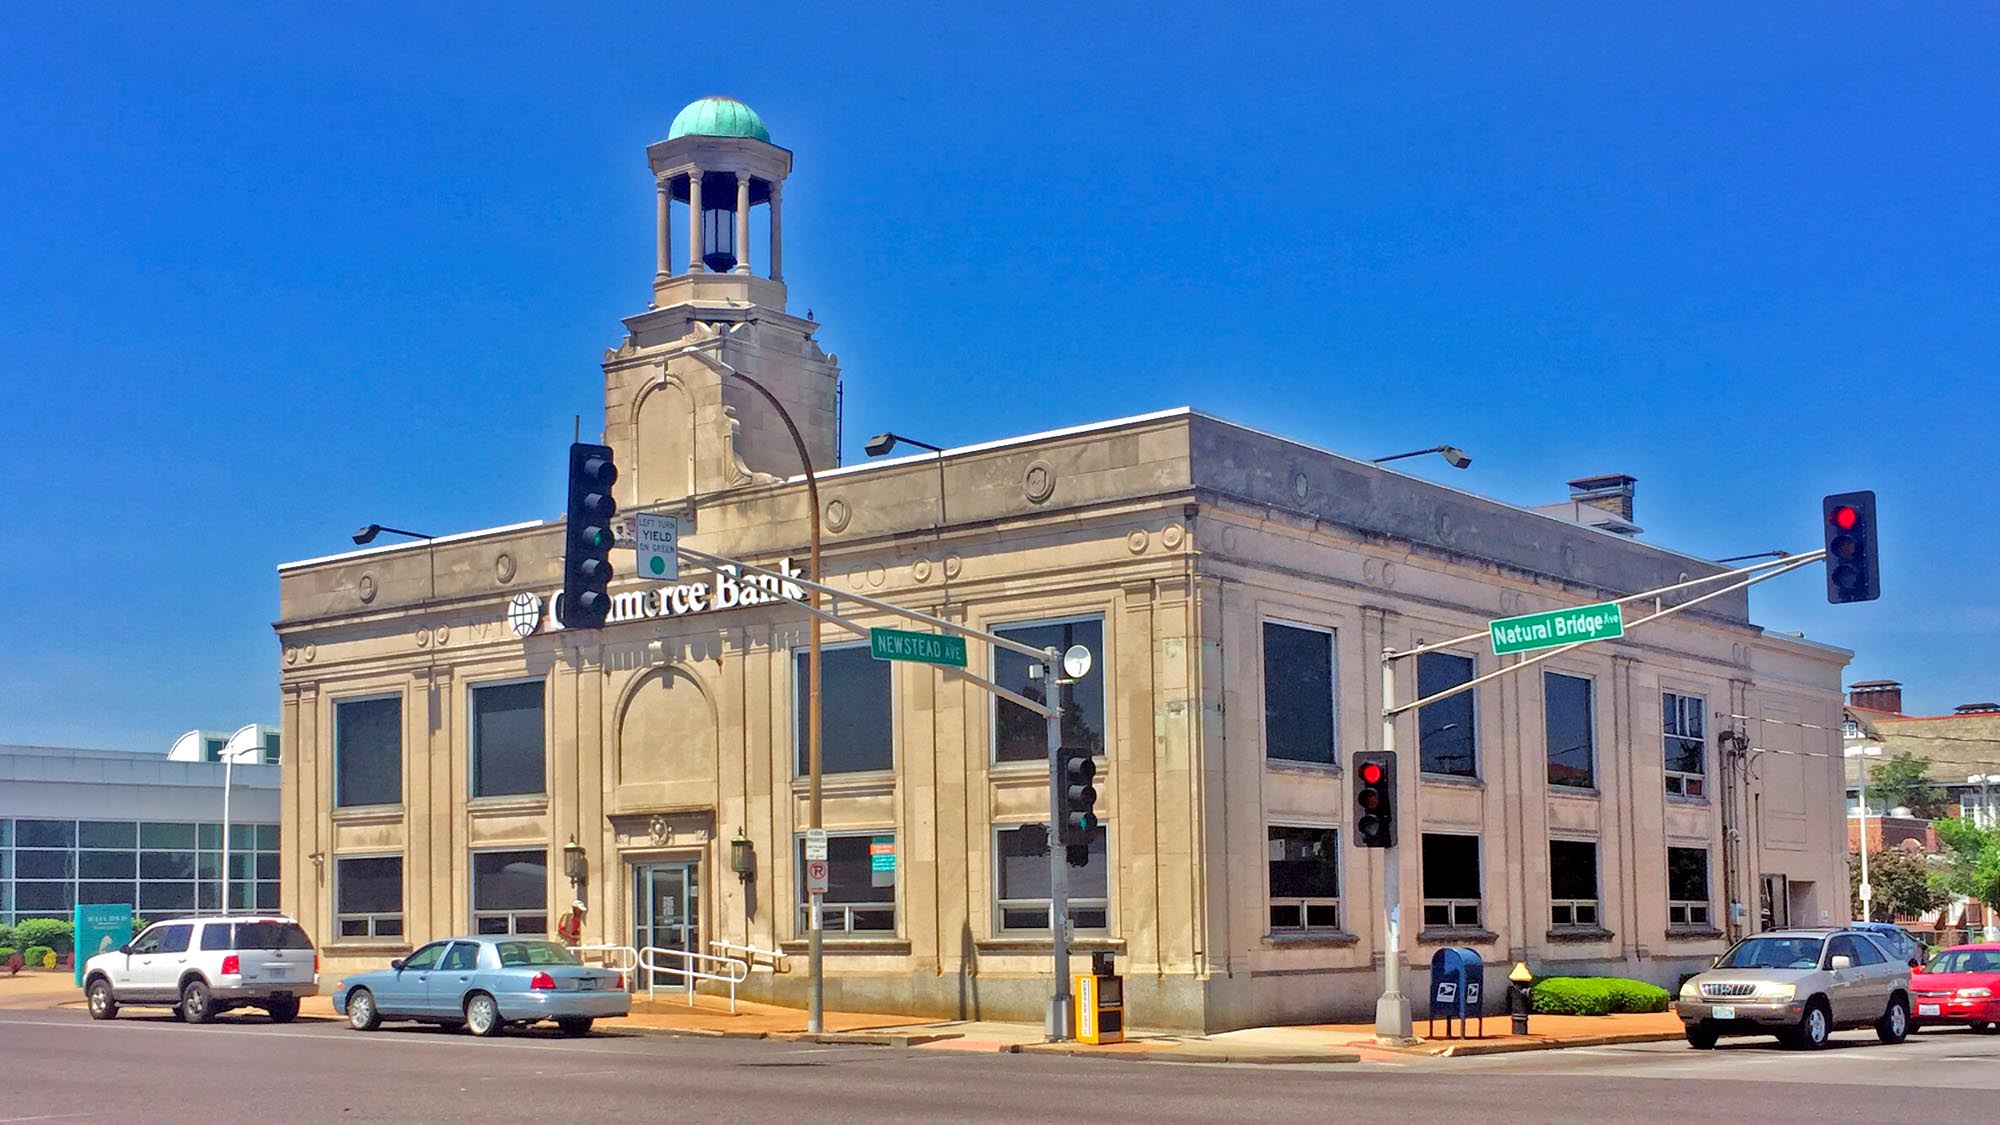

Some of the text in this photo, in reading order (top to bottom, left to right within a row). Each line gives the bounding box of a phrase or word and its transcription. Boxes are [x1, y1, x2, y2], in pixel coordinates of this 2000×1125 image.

[639, 518, 675, 529] LEFT TURN
[643, 530, 672, 542] YIELD
[640, 542, 675, 553] ON GREEN
[716, 557, 807, 609] Bank
[1494, 612, 1619, 646] Natural Bridge Ave
[878, 634, 961, 660] NEWSTEAD AVE
